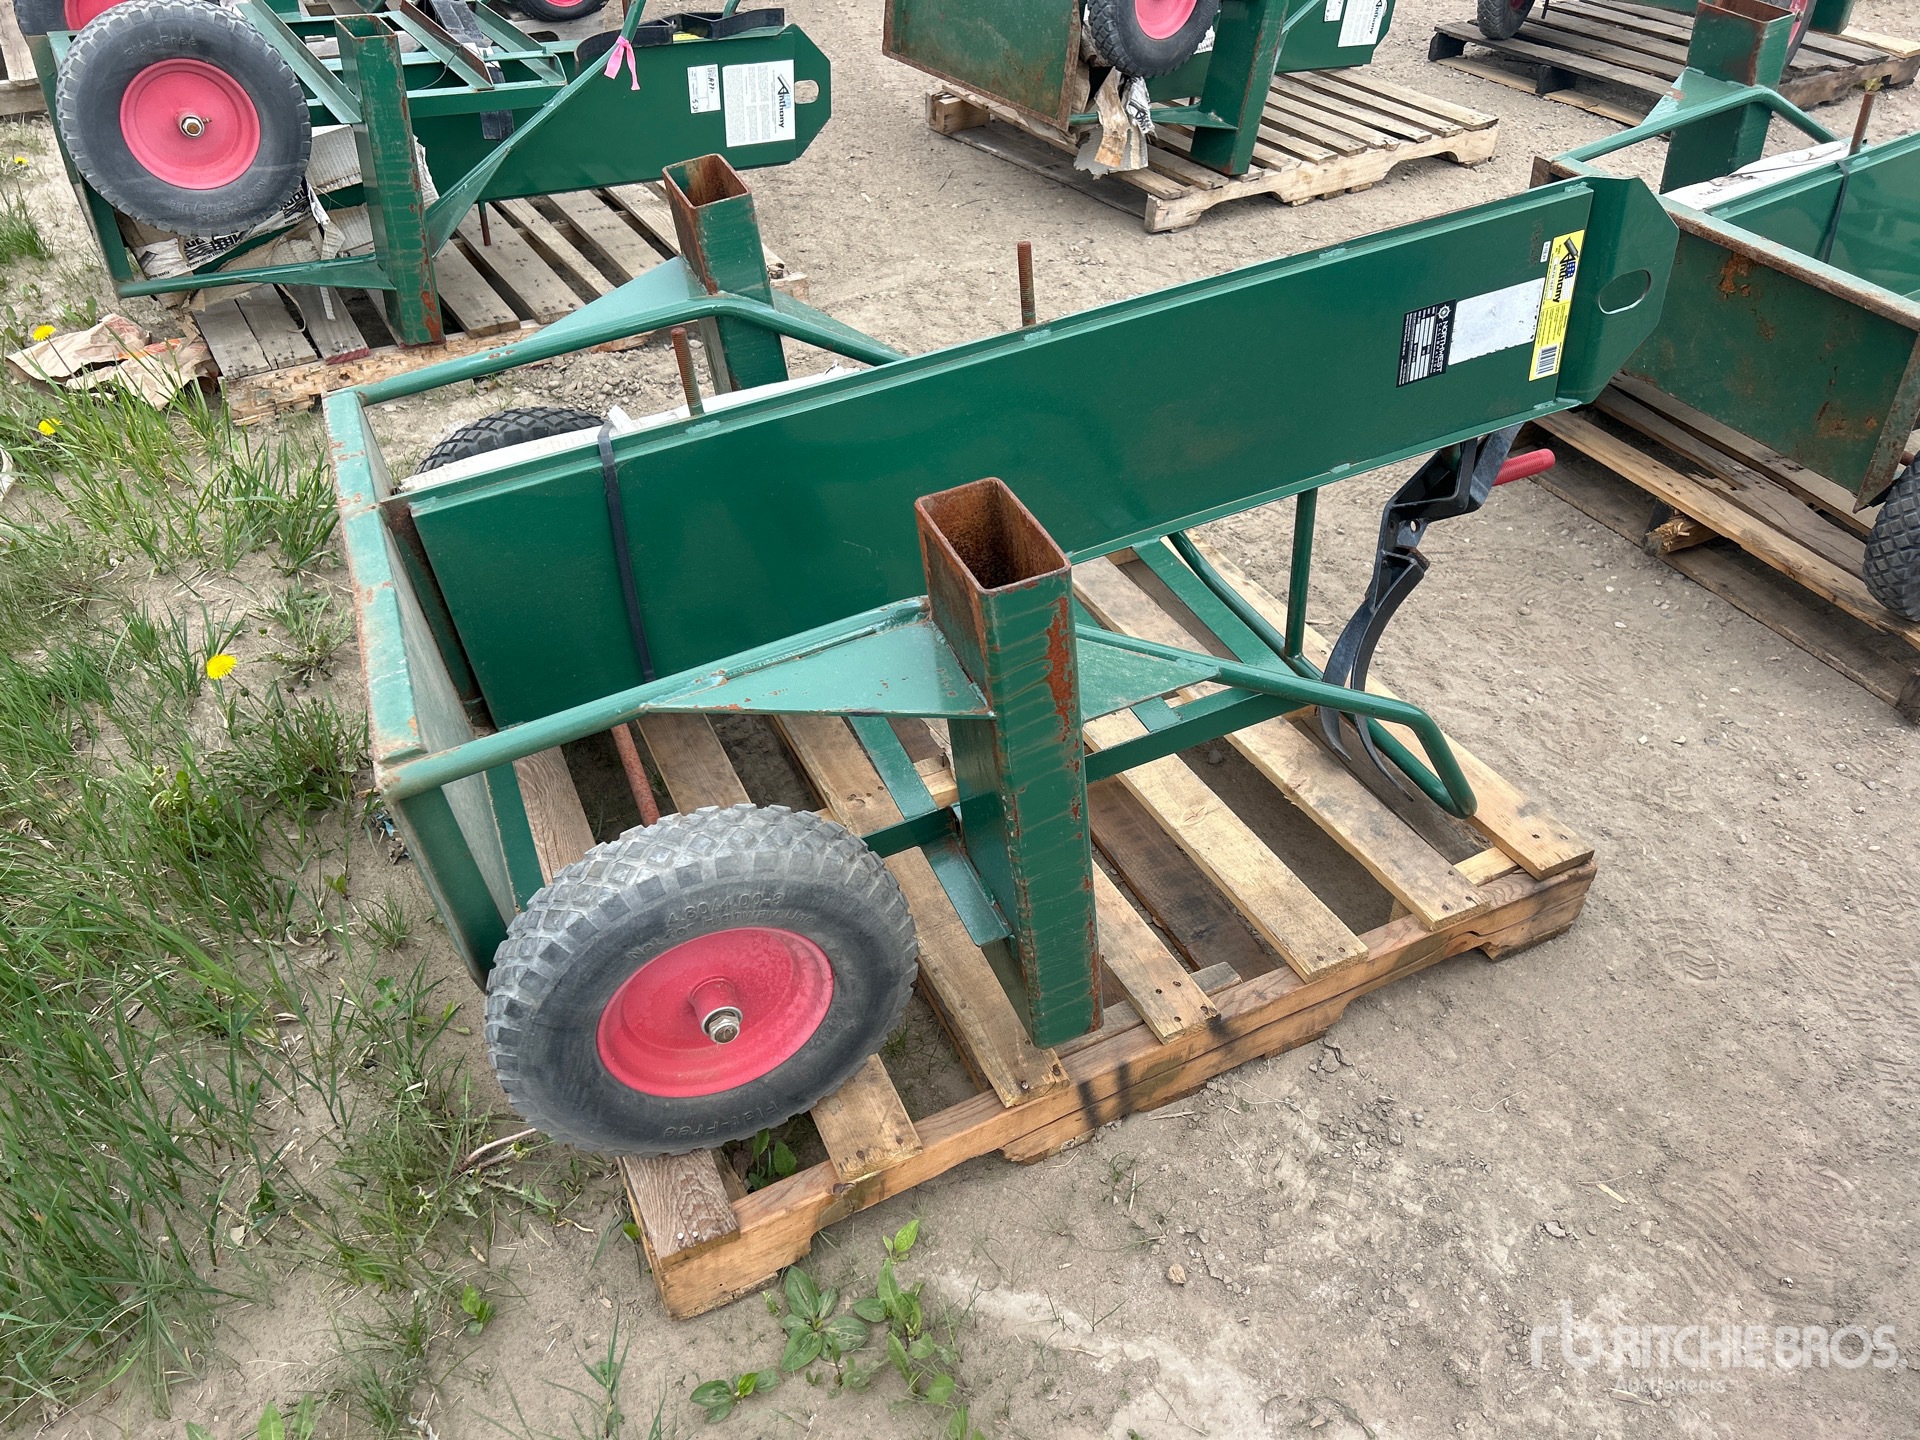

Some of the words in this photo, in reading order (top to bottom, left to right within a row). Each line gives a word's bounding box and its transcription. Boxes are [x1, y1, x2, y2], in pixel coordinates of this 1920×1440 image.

[777, 76, 790, 128] Anthony
[1553, 252, 1576, 302] Anthony
[1436, 320, 1449, 372] NORTHWEST
[627, 939, 663, 960] Not
[664, 925, 695, 940] for
[702, 909, 781, 928] Highway
[662, 1100, 778, 1138] Flat-Free
